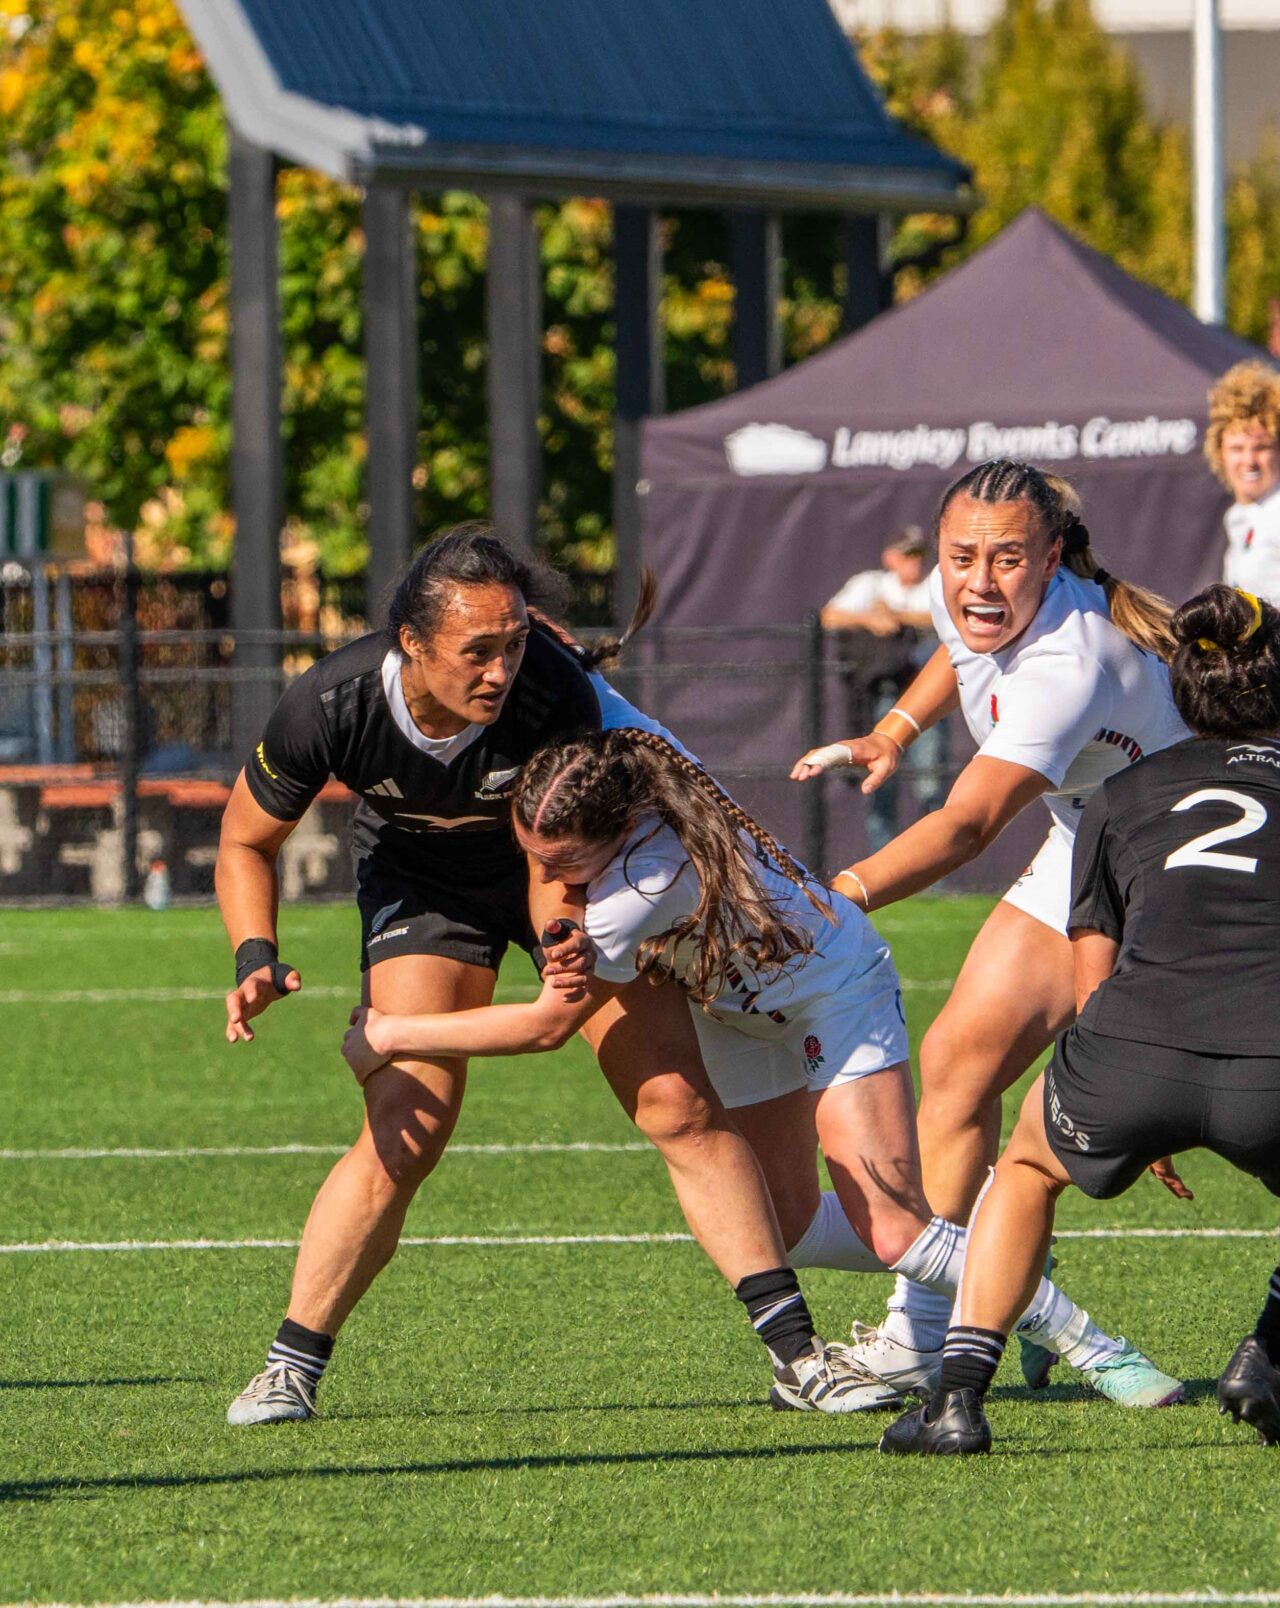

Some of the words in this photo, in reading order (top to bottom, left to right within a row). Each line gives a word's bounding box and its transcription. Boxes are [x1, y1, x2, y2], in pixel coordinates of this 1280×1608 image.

[831, 424, 967, 470] Langley
[966, 421, 1079, 462] Events
[1080, 415, 1197, 458] Centre
[1048, 1068, 1091, 1151] INEOS
